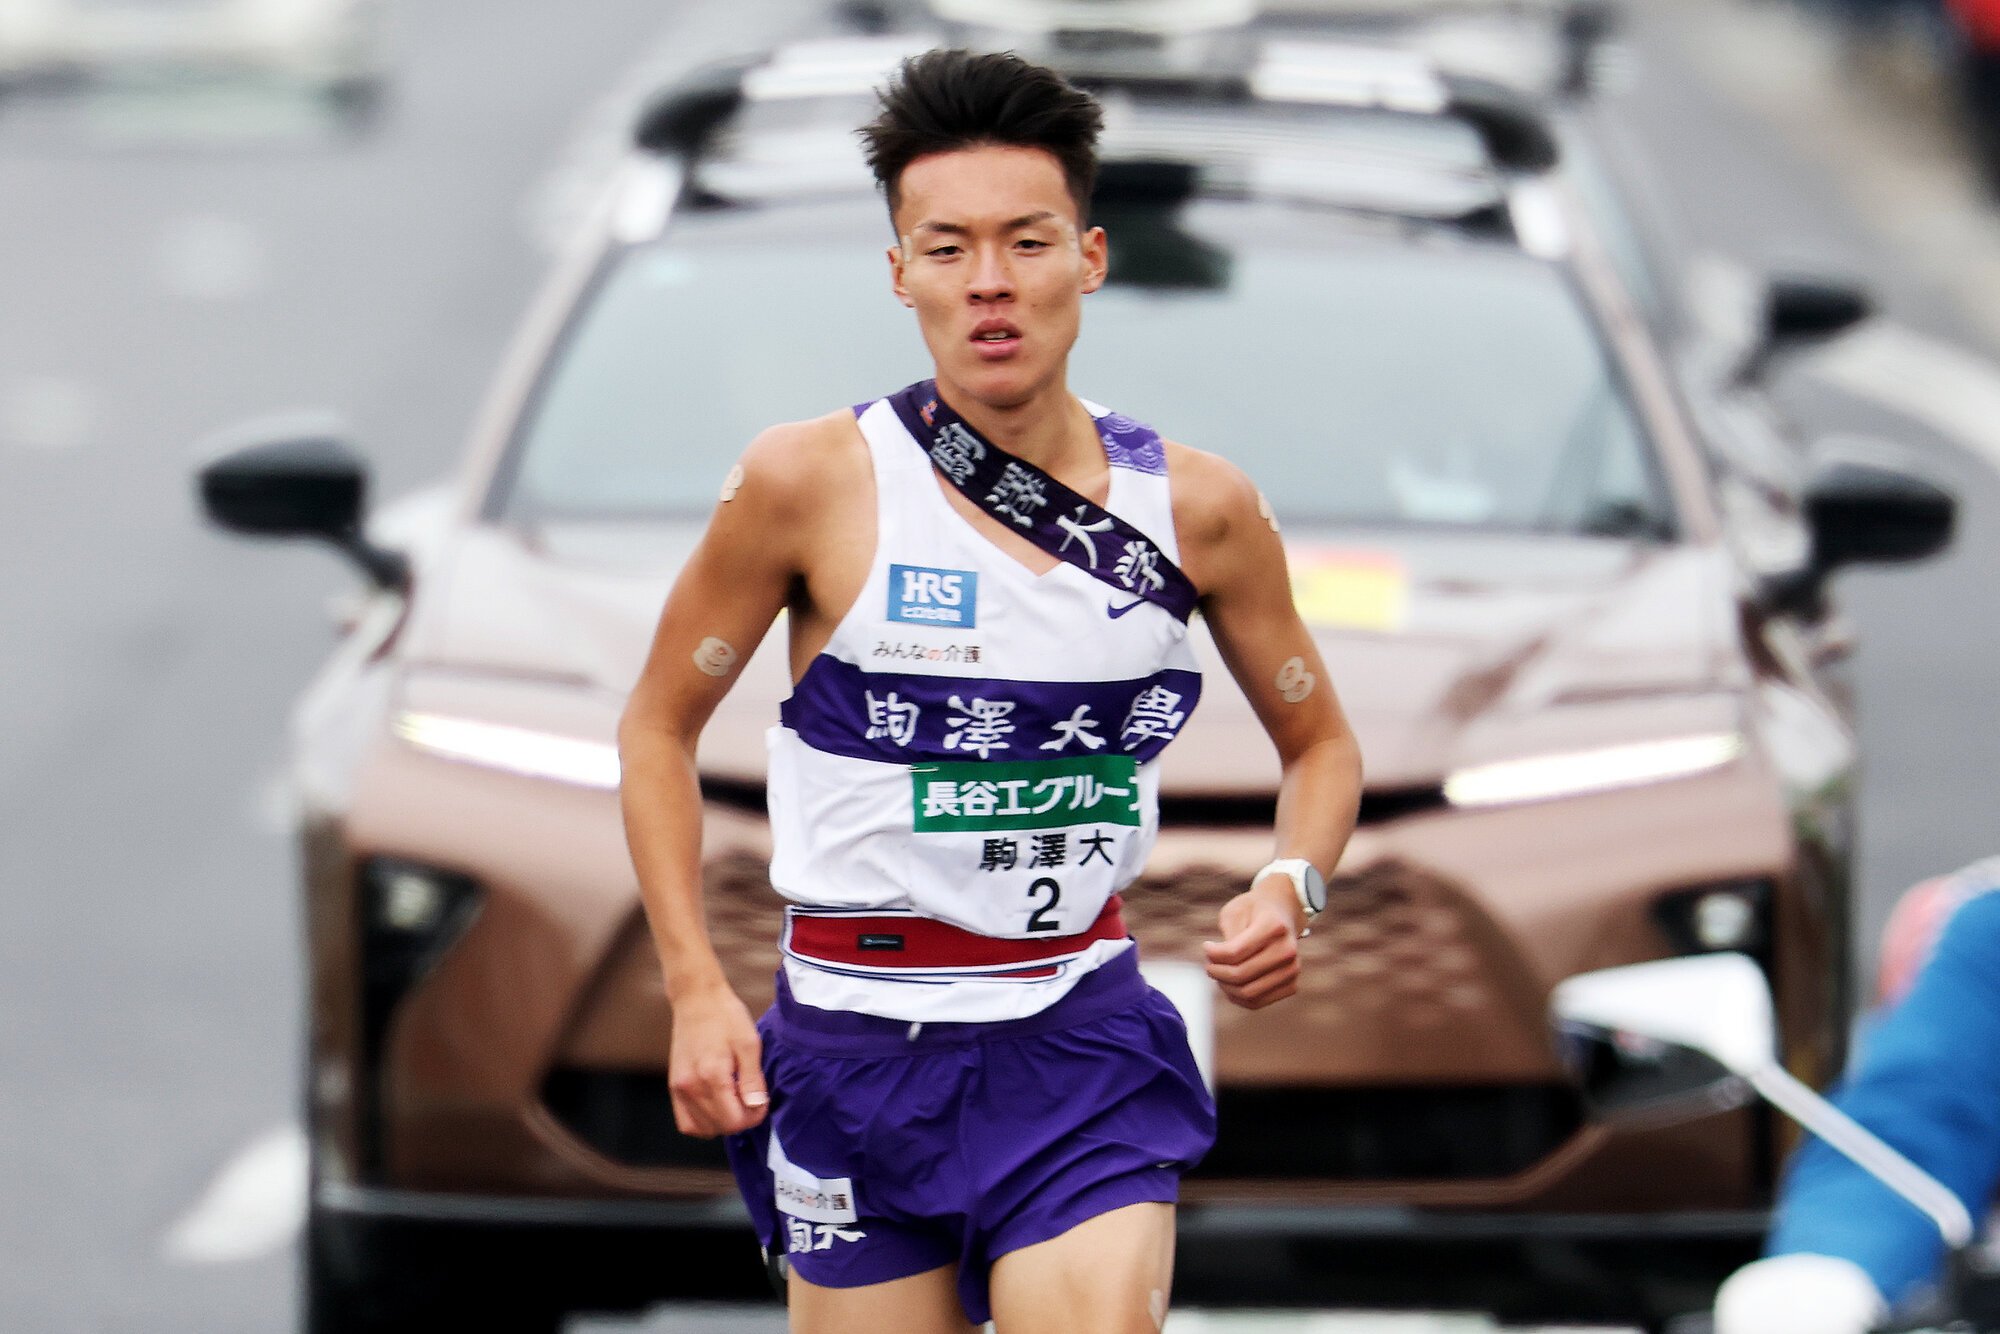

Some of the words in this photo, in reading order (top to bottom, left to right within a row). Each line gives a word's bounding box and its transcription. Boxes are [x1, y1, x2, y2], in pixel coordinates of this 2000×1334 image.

[901, 570, 963, 606] HRS
[873, 640, 982, 664] みんなの介護
[979, 829, 1115, 871] 駒澤大
[1026, 876, 1061, 932] 2
